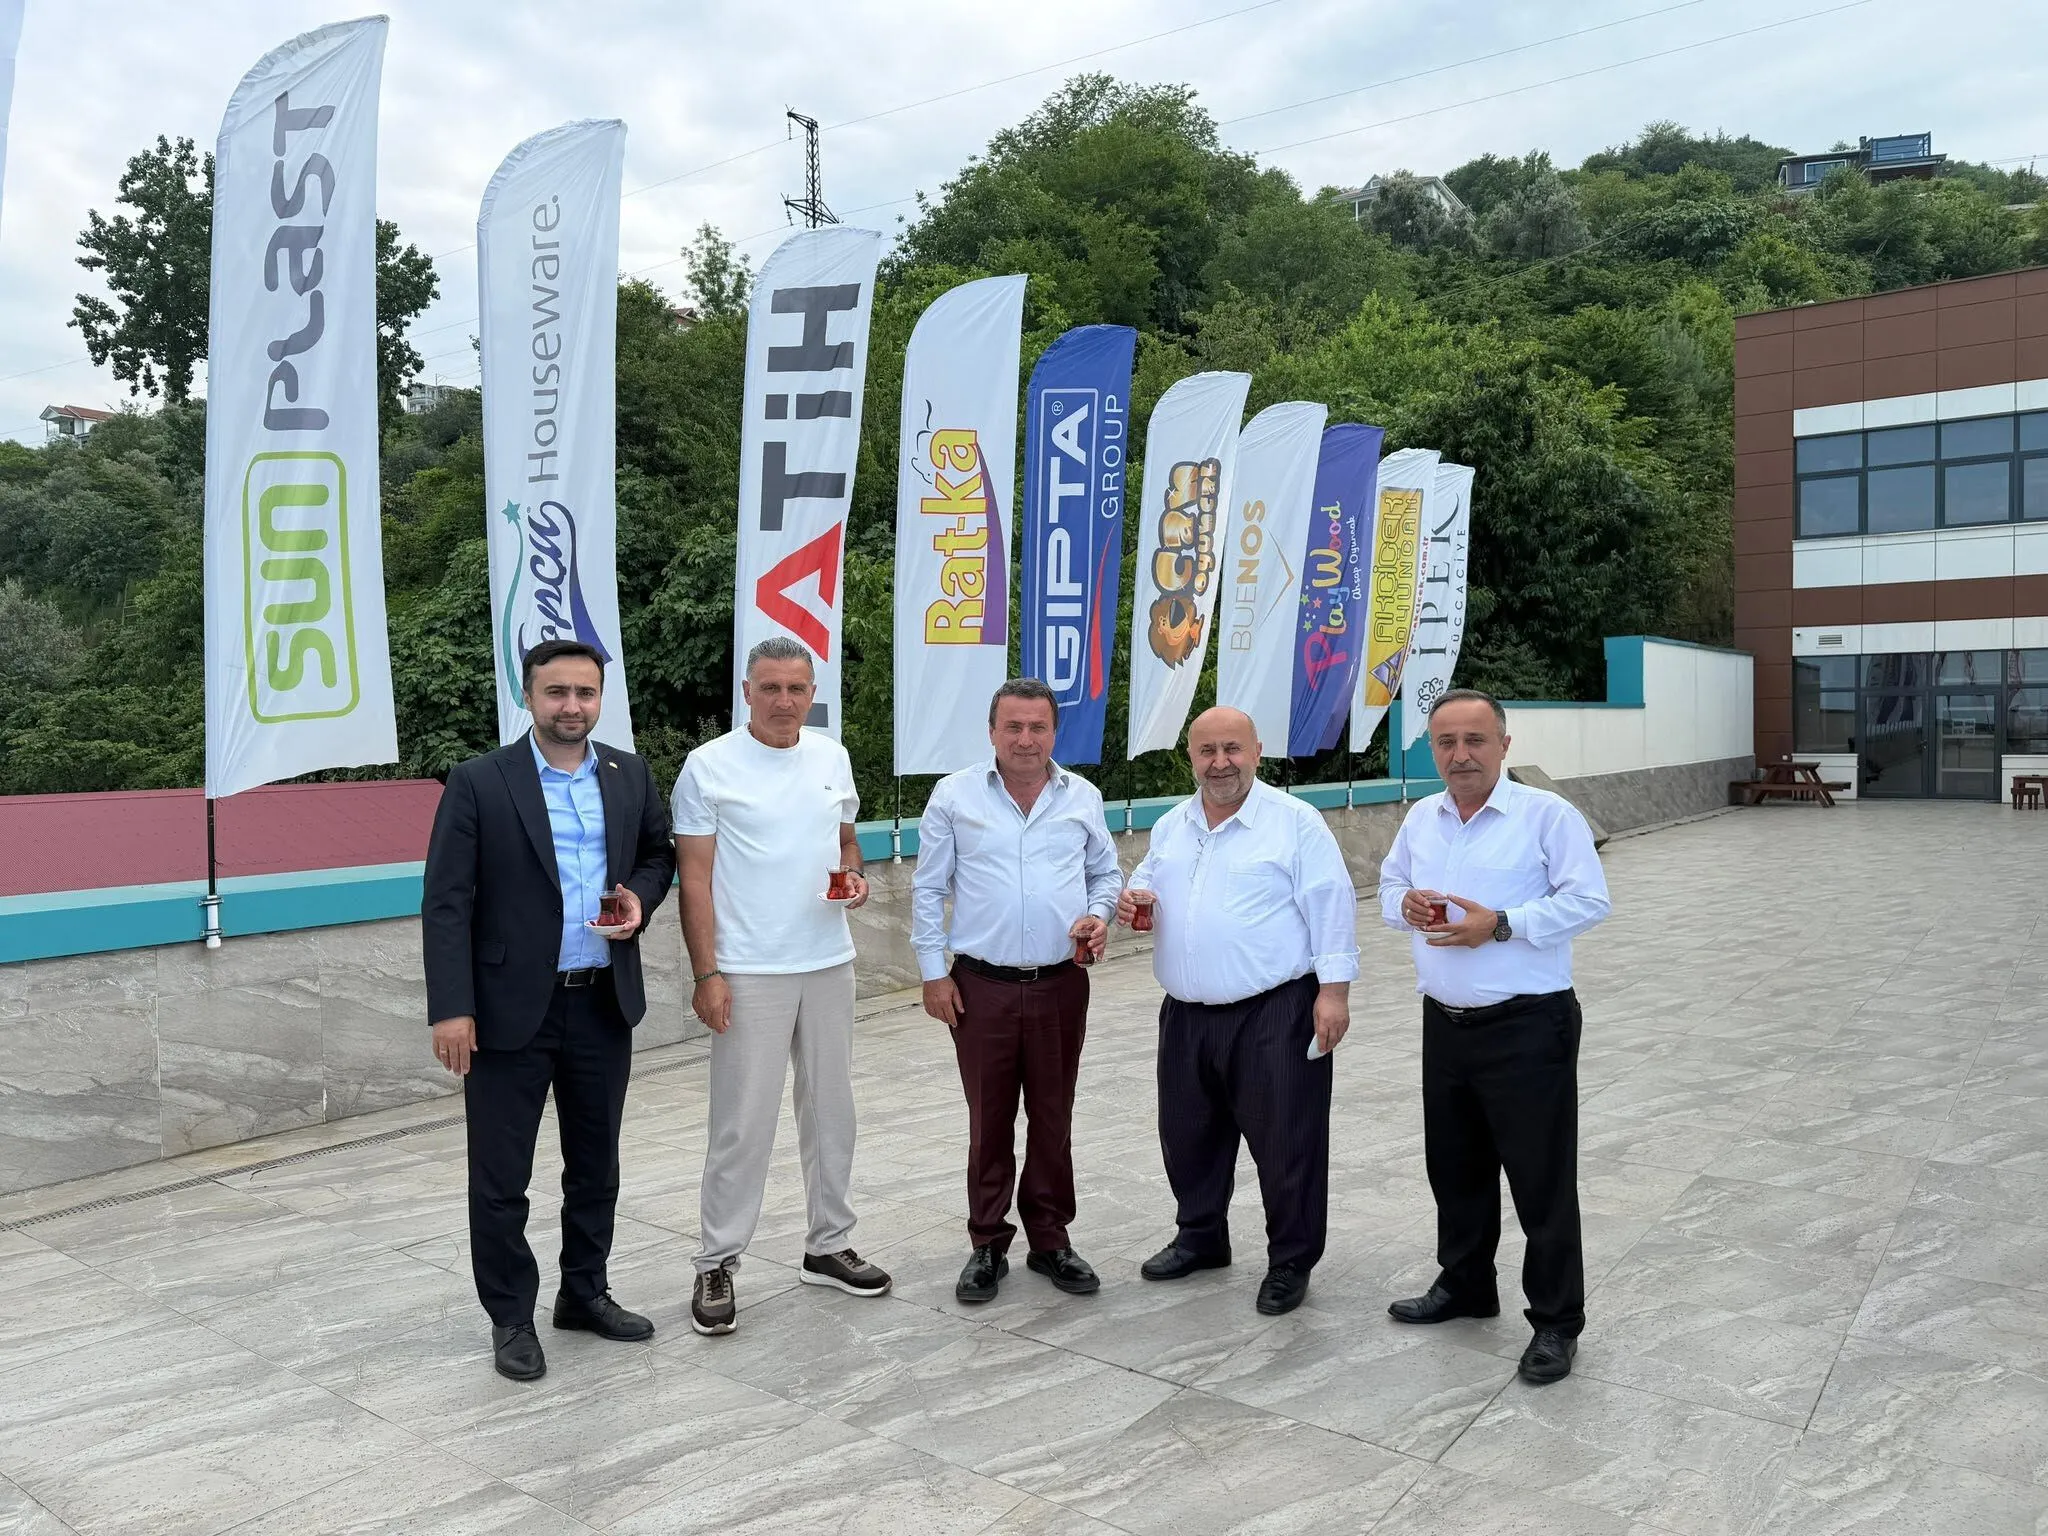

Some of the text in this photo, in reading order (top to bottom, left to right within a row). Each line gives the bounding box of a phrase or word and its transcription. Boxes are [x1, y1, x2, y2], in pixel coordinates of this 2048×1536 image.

[527, 193, 562, 485] Houseware.
[1101, 393, 1125, 519] GROUP
[1151, 461, 1201, 594] Can
[1194, 457, 1222, 597] Oyuncak
[920, 428, 989, 645] Rat-ka
[1230, 499, 1267, 652] BUENOS
[1303, 500, 1351, 692] PlayWood
[1347, 514, 1363, 565] Oyuncak
[1395, 498, 1418, 645] OYUNCAK
